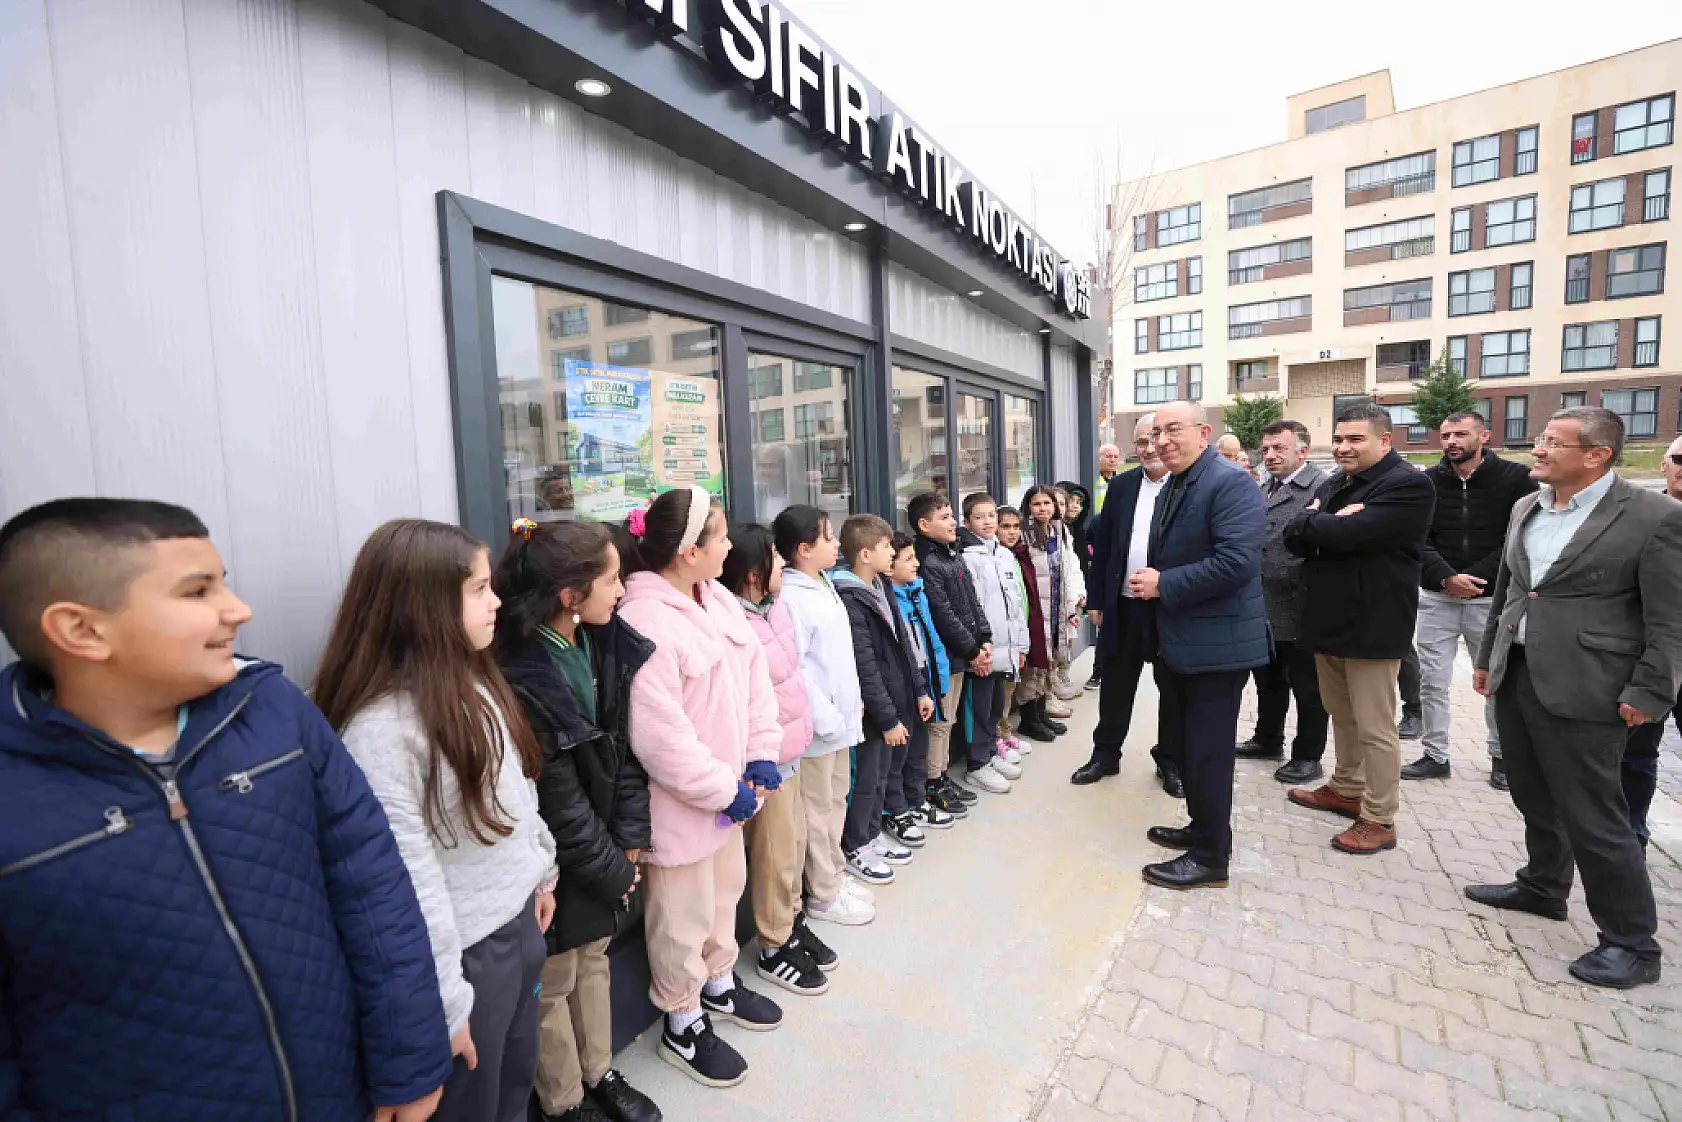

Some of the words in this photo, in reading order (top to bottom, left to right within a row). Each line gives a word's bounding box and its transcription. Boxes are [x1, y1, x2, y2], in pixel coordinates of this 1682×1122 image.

[719, 0, 872, 160] SIFIR
[886, 111, 965, 227] ATIK
[971, 180, 1058, 295] NOKTASI
[1320, 349, 1331, 359] D2
